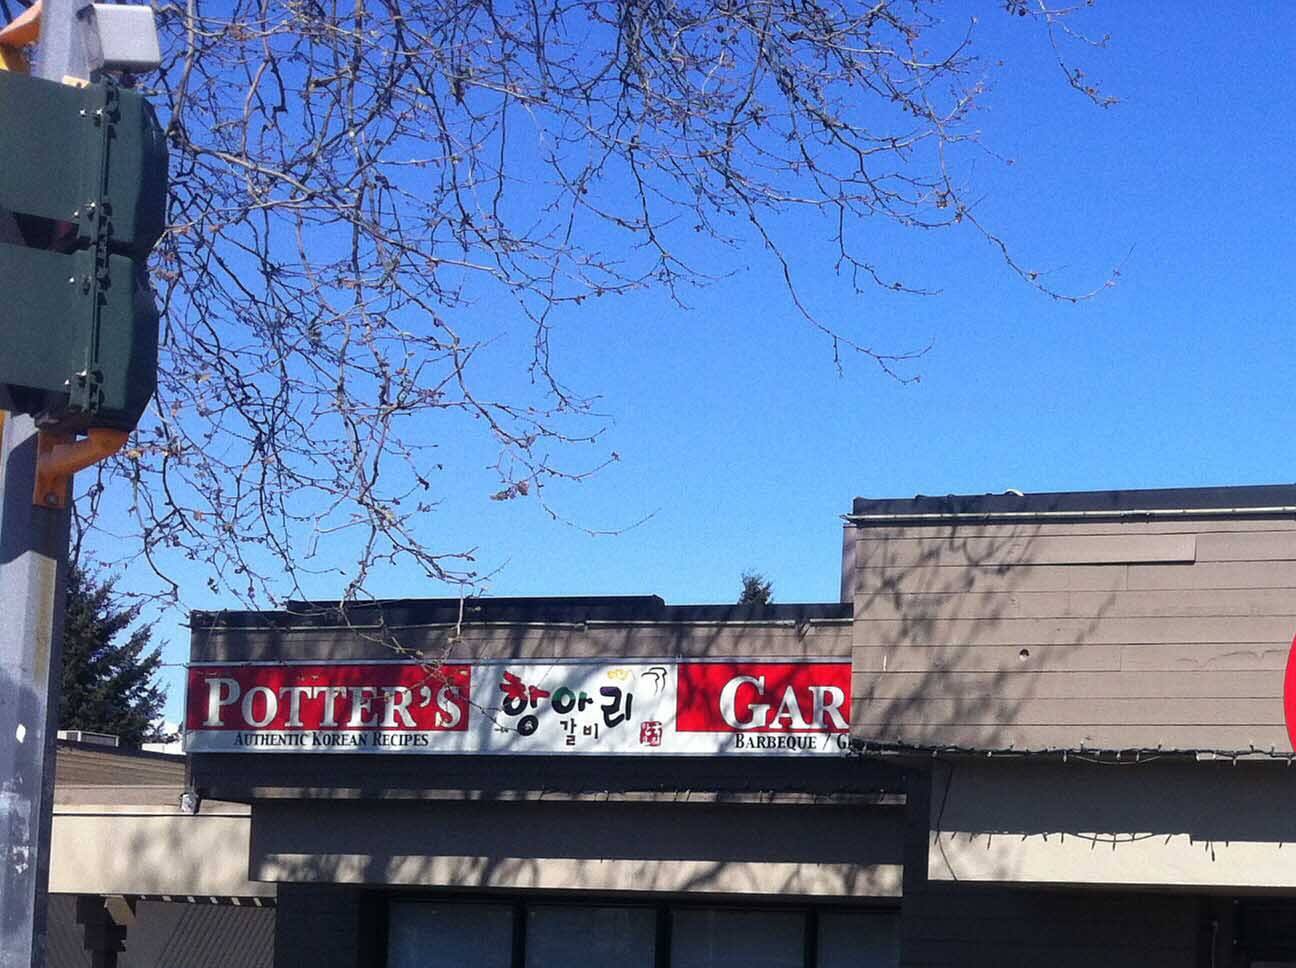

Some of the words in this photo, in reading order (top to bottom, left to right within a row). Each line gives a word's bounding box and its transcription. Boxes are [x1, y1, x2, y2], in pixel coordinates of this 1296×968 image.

[203, 677, 461, 728] POTTER'S
[719, 675, 849, 730] GAR
[233, 730, 309, 746] AUTHENTIC
[312, 730, 368, 747] KOREAN
[373, 731, 429, 747] RECIPES
[559, 718, 599, 746] 갈비
[735, 733, 817, 751] BARBEQUE
